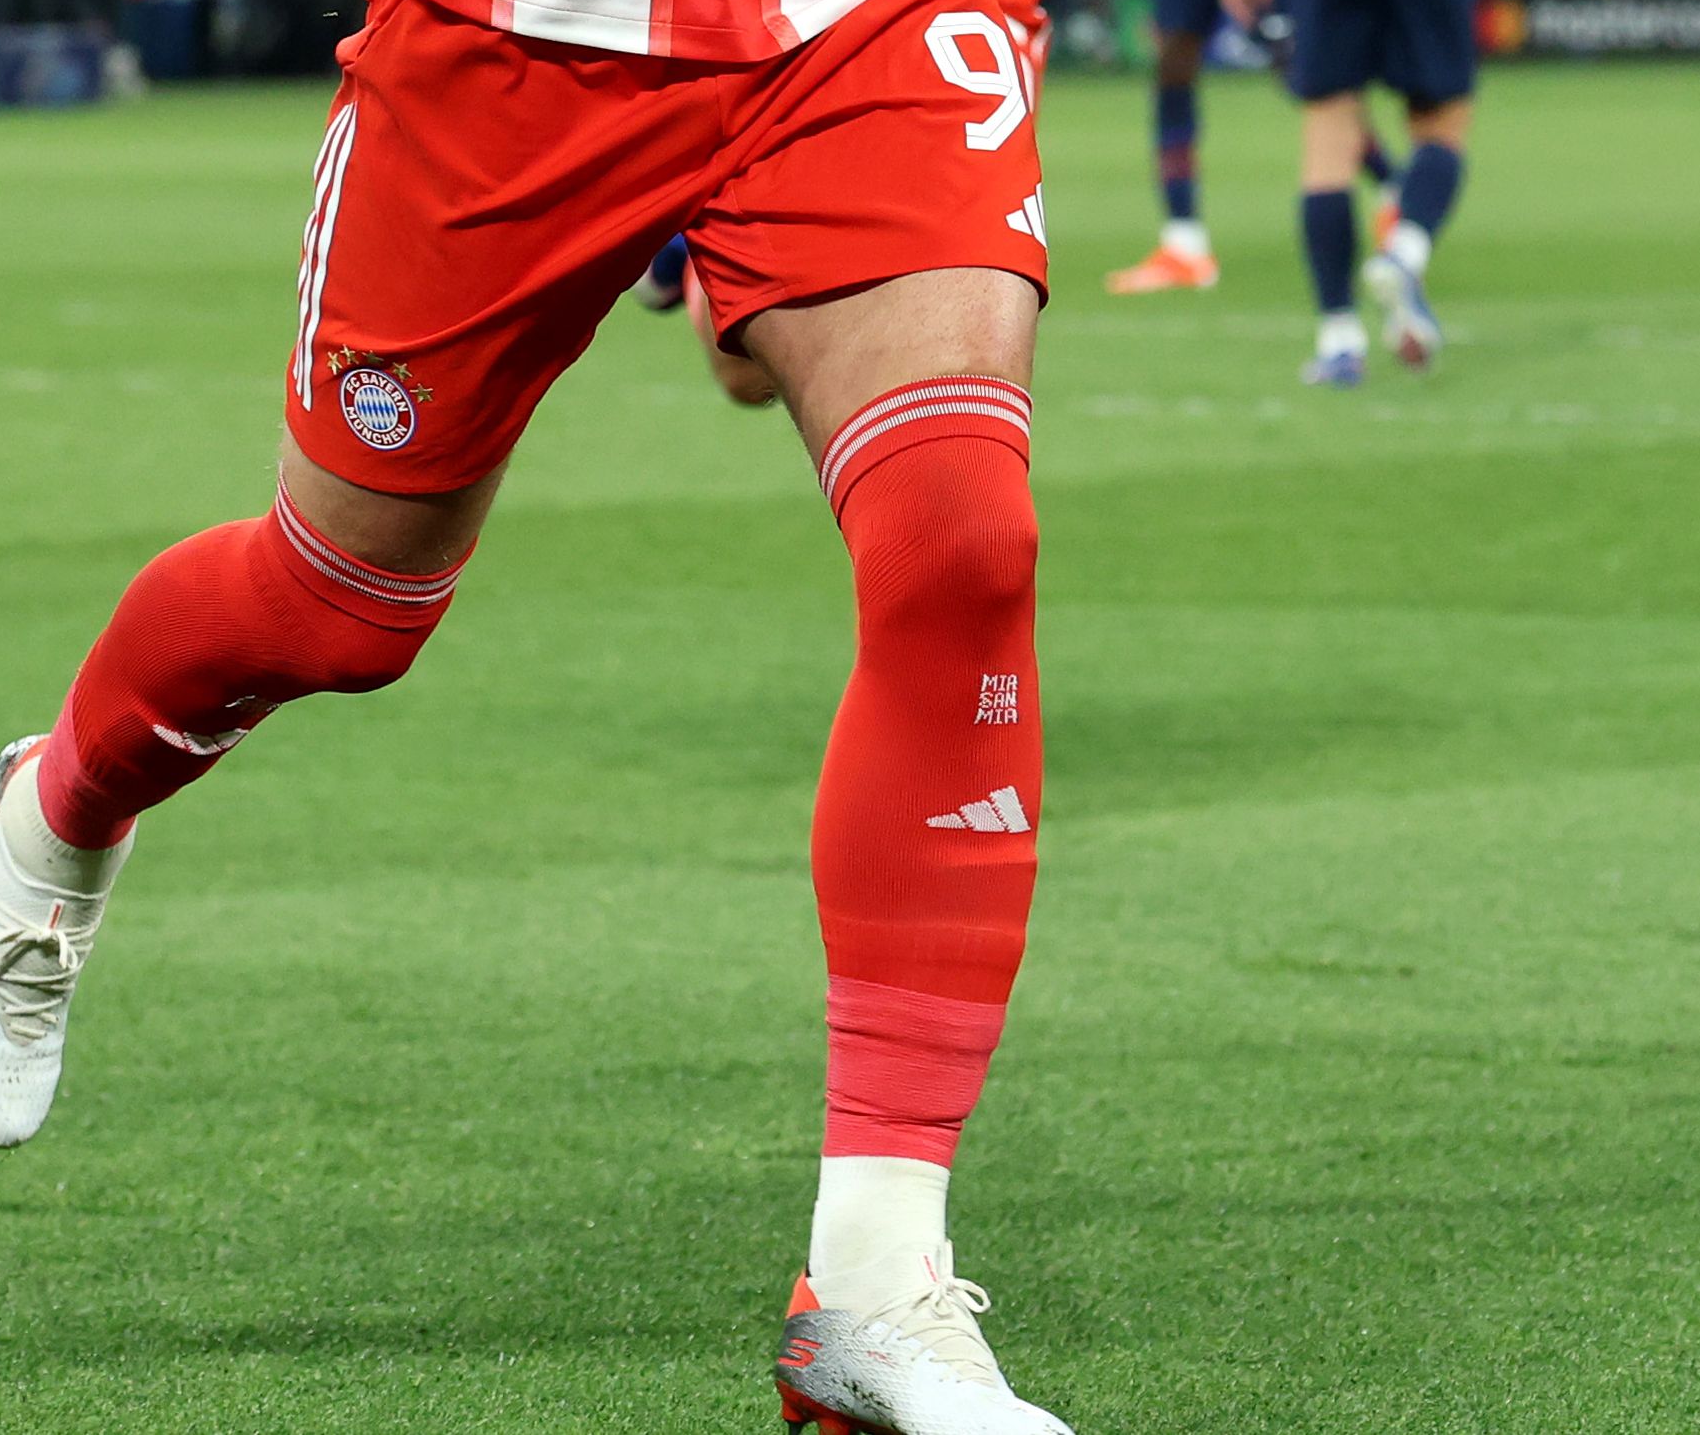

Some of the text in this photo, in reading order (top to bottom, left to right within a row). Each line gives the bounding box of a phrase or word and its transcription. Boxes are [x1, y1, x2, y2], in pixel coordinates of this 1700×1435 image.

[923, 11, 1027, 152] 9
[345, 373, 409, 413] FC BAYERN
[981, 673, 1018, 691] MIA
[978, 691, 1017, 708] SAN
[973, 708, 1018, 725] MIA
